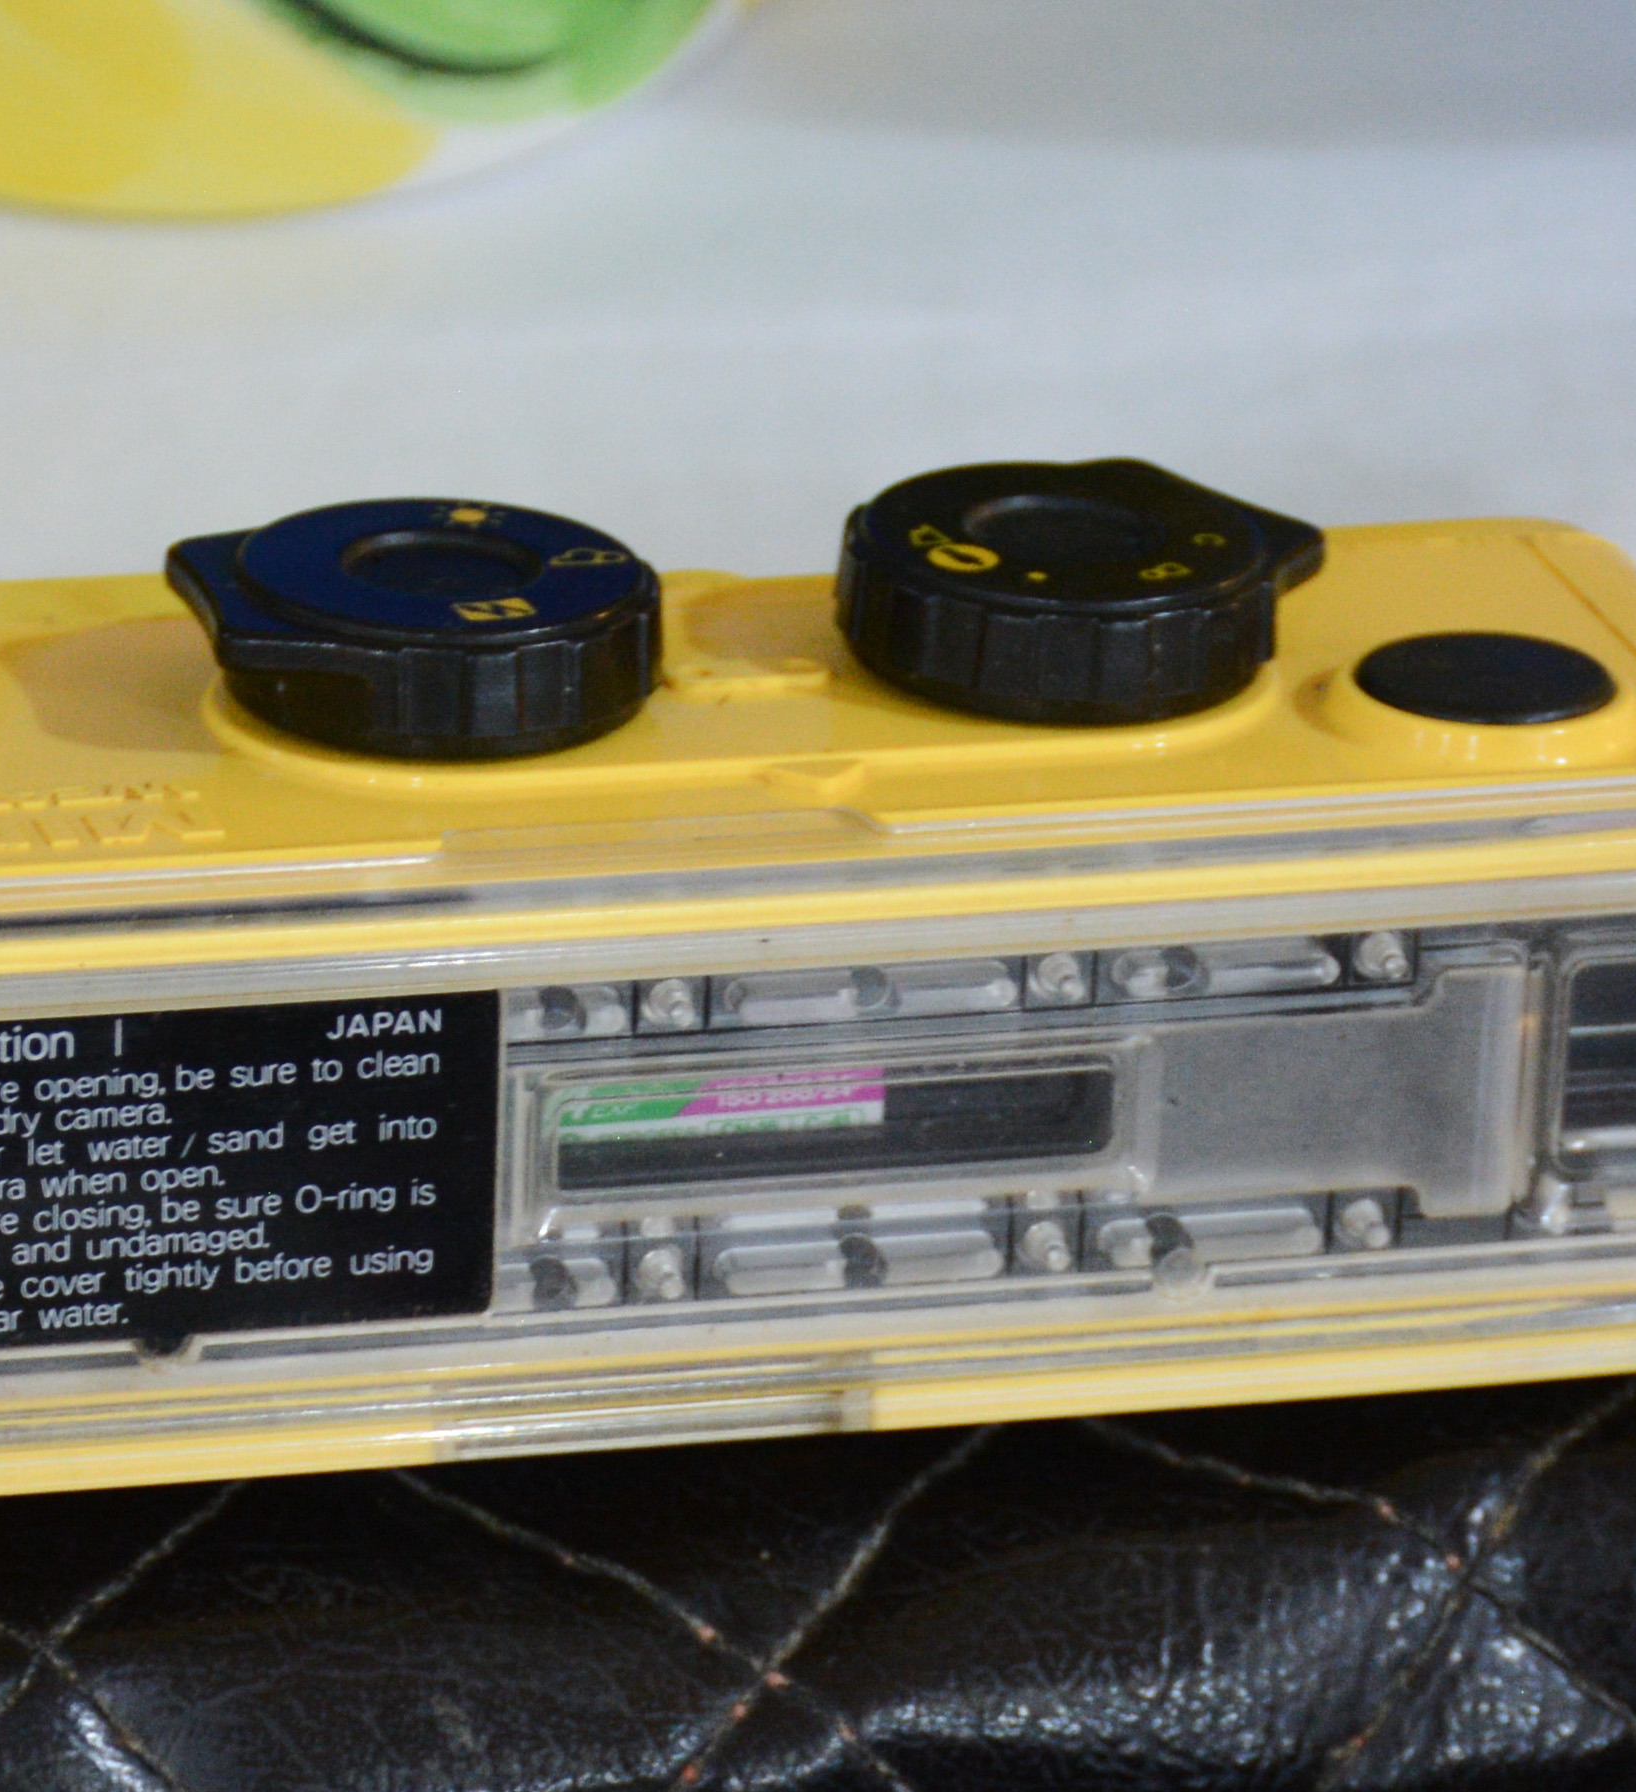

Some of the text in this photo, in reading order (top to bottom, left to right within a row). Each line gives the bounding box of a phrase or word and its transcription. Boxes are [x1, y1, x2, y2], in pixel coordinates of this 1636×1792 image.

[327, 1009, 442, 1041] JAPAN
[34, 1070, 164, 1104] opening,
[175, 1066, 214, 1092] be
[229, 1061, 297, 1087] sure
[312, 1059, 343, 1083] to
[357, 1051, 439, 1080] clean
[54, 1102, 173, 1133] camera.
[27, 1139, 64, 1165] let
[88, 1136, 170, 1162] water
[208, 1122, 284, 1152] sand
[308, 1119, 356, 1149] get
[378, 1114, 437, 1140] into
[40, 1169, 127, 1197] when
[140, 1164, 225, 1195] open.
[33, 1202, 151, 1235] closing,
[161, 1196, 200, 1223] be
[215, 1192, 281, 1218] sure
[295, 1182, 396, 1213] O-ring
[411, 1180, 436, 1206] is
[12, 1238, 70, 1265] and
[86, 1223, 270, 1264] undamaged.
[21, 1270, 102, 1298] cover
[125, 1261, 219, 1294] tightly
[234, 1252, 331, 1282] before
[349, 1245, 434, 1279] using
[39, 1301, 128, 1329] water.
